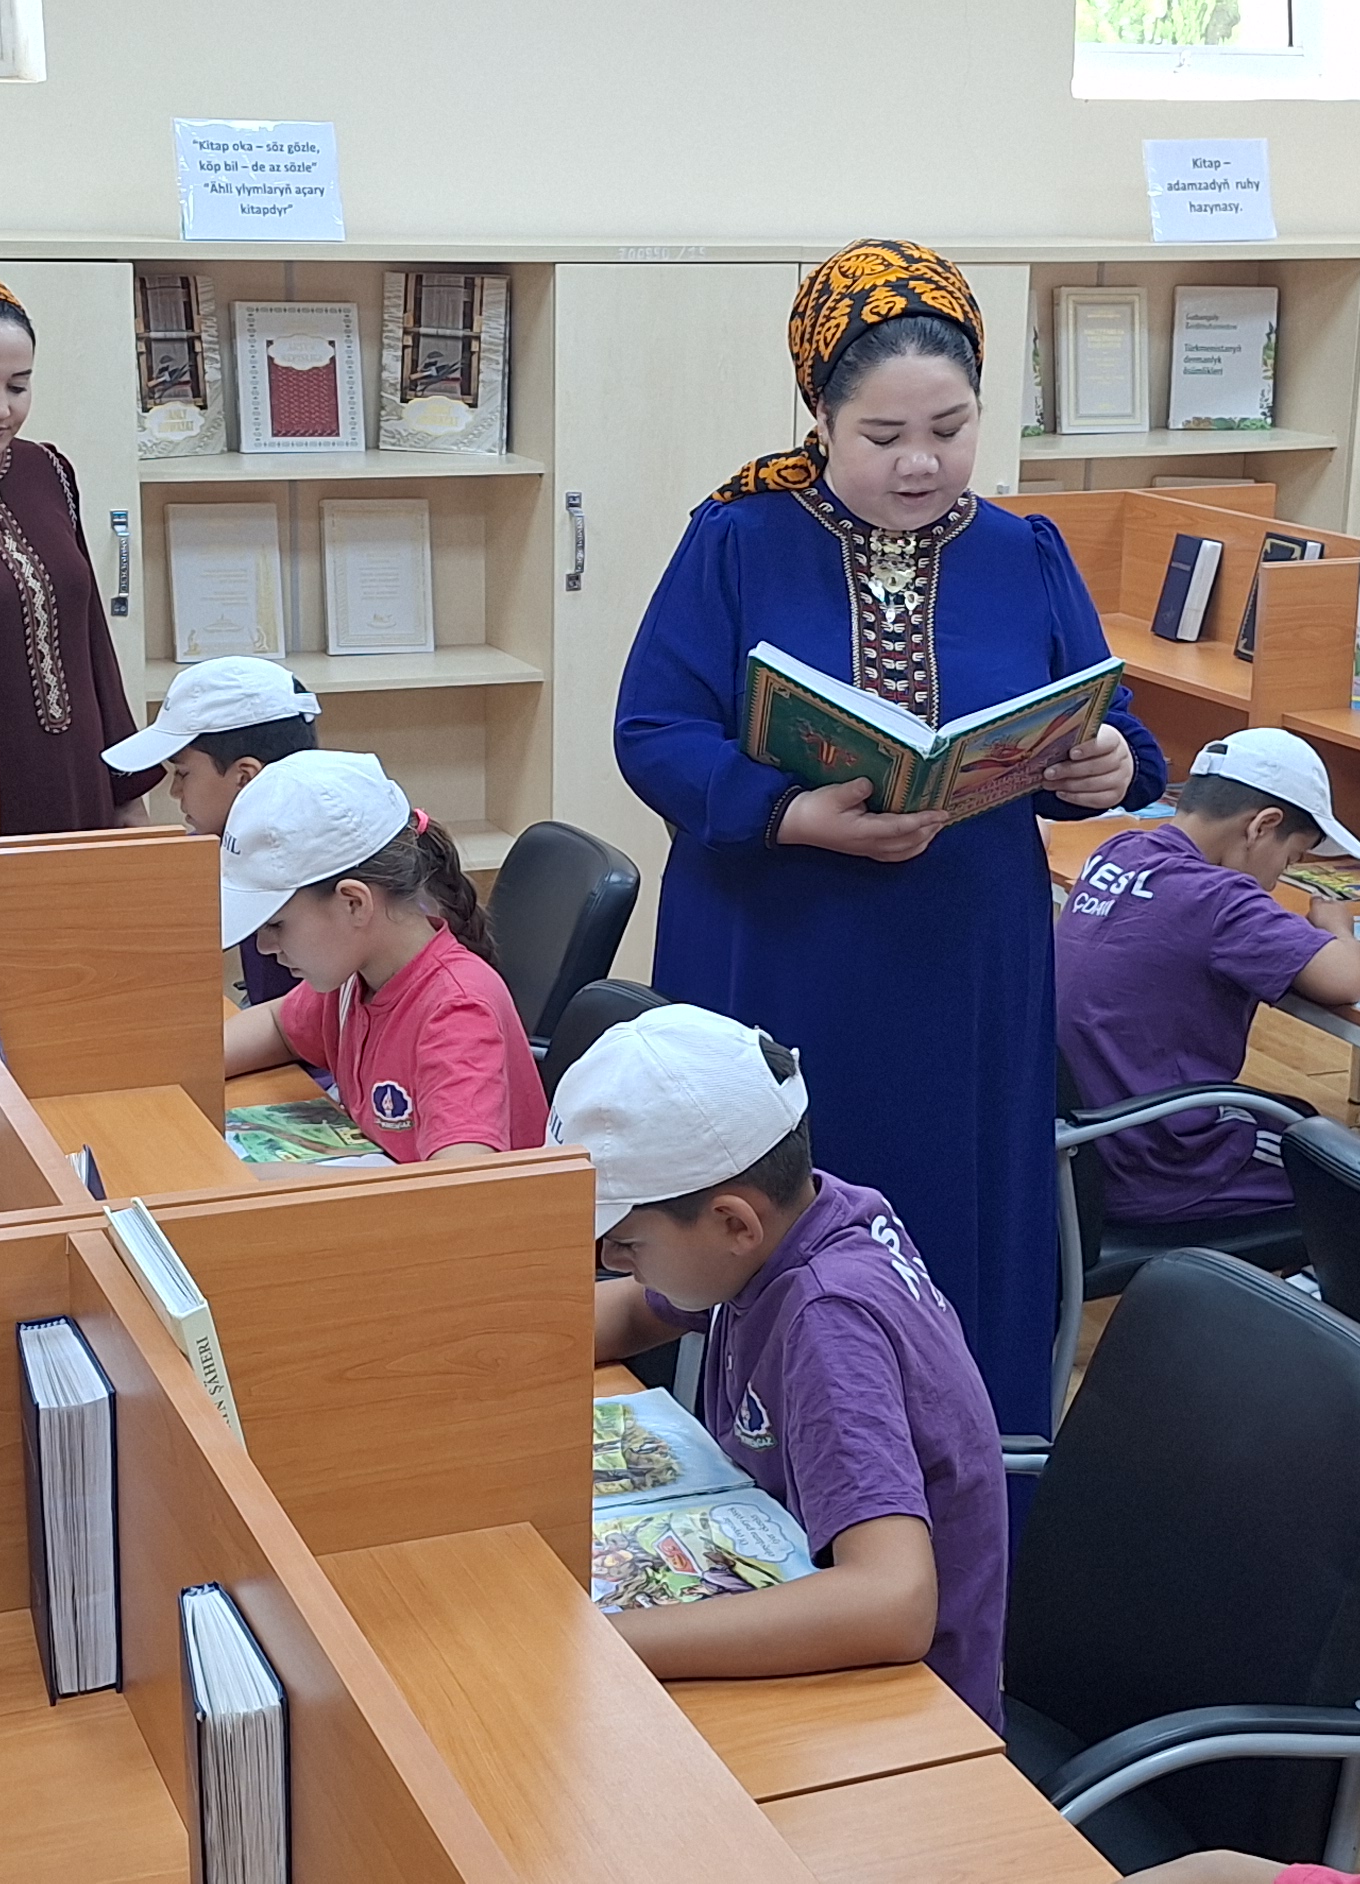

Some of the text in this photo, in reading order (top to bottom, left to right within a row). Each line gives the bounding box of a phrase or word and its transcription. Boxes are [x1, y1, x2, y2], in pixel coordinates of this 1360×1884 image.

[192, 139, 229, 154] “Kitap
[232, 141, 253, 152] oka
[266, 142, 284, 152] söz
[287, 141, 320, 155] gözle,
[199, 160, 221, 174] köp
[224, 160, 238, 172] bil
[251, 161, 266, 172] de
[269, 164, 281, 173] az
[283, 162, 317, 173] sözle”
[1192, 157, 1221, 171] Kitap
[235, 183, 292, 197] ylymlaryň
[295, 185, 325, 197] açary
[1167, 178, 1260, 193] adamzadyň ruhy
[240, 203, 293, 217] kitapdyr”
[1189, 201, 1243, 214] hazynasy.
[196, 1335, 225, 1396] ŞÄHERI
